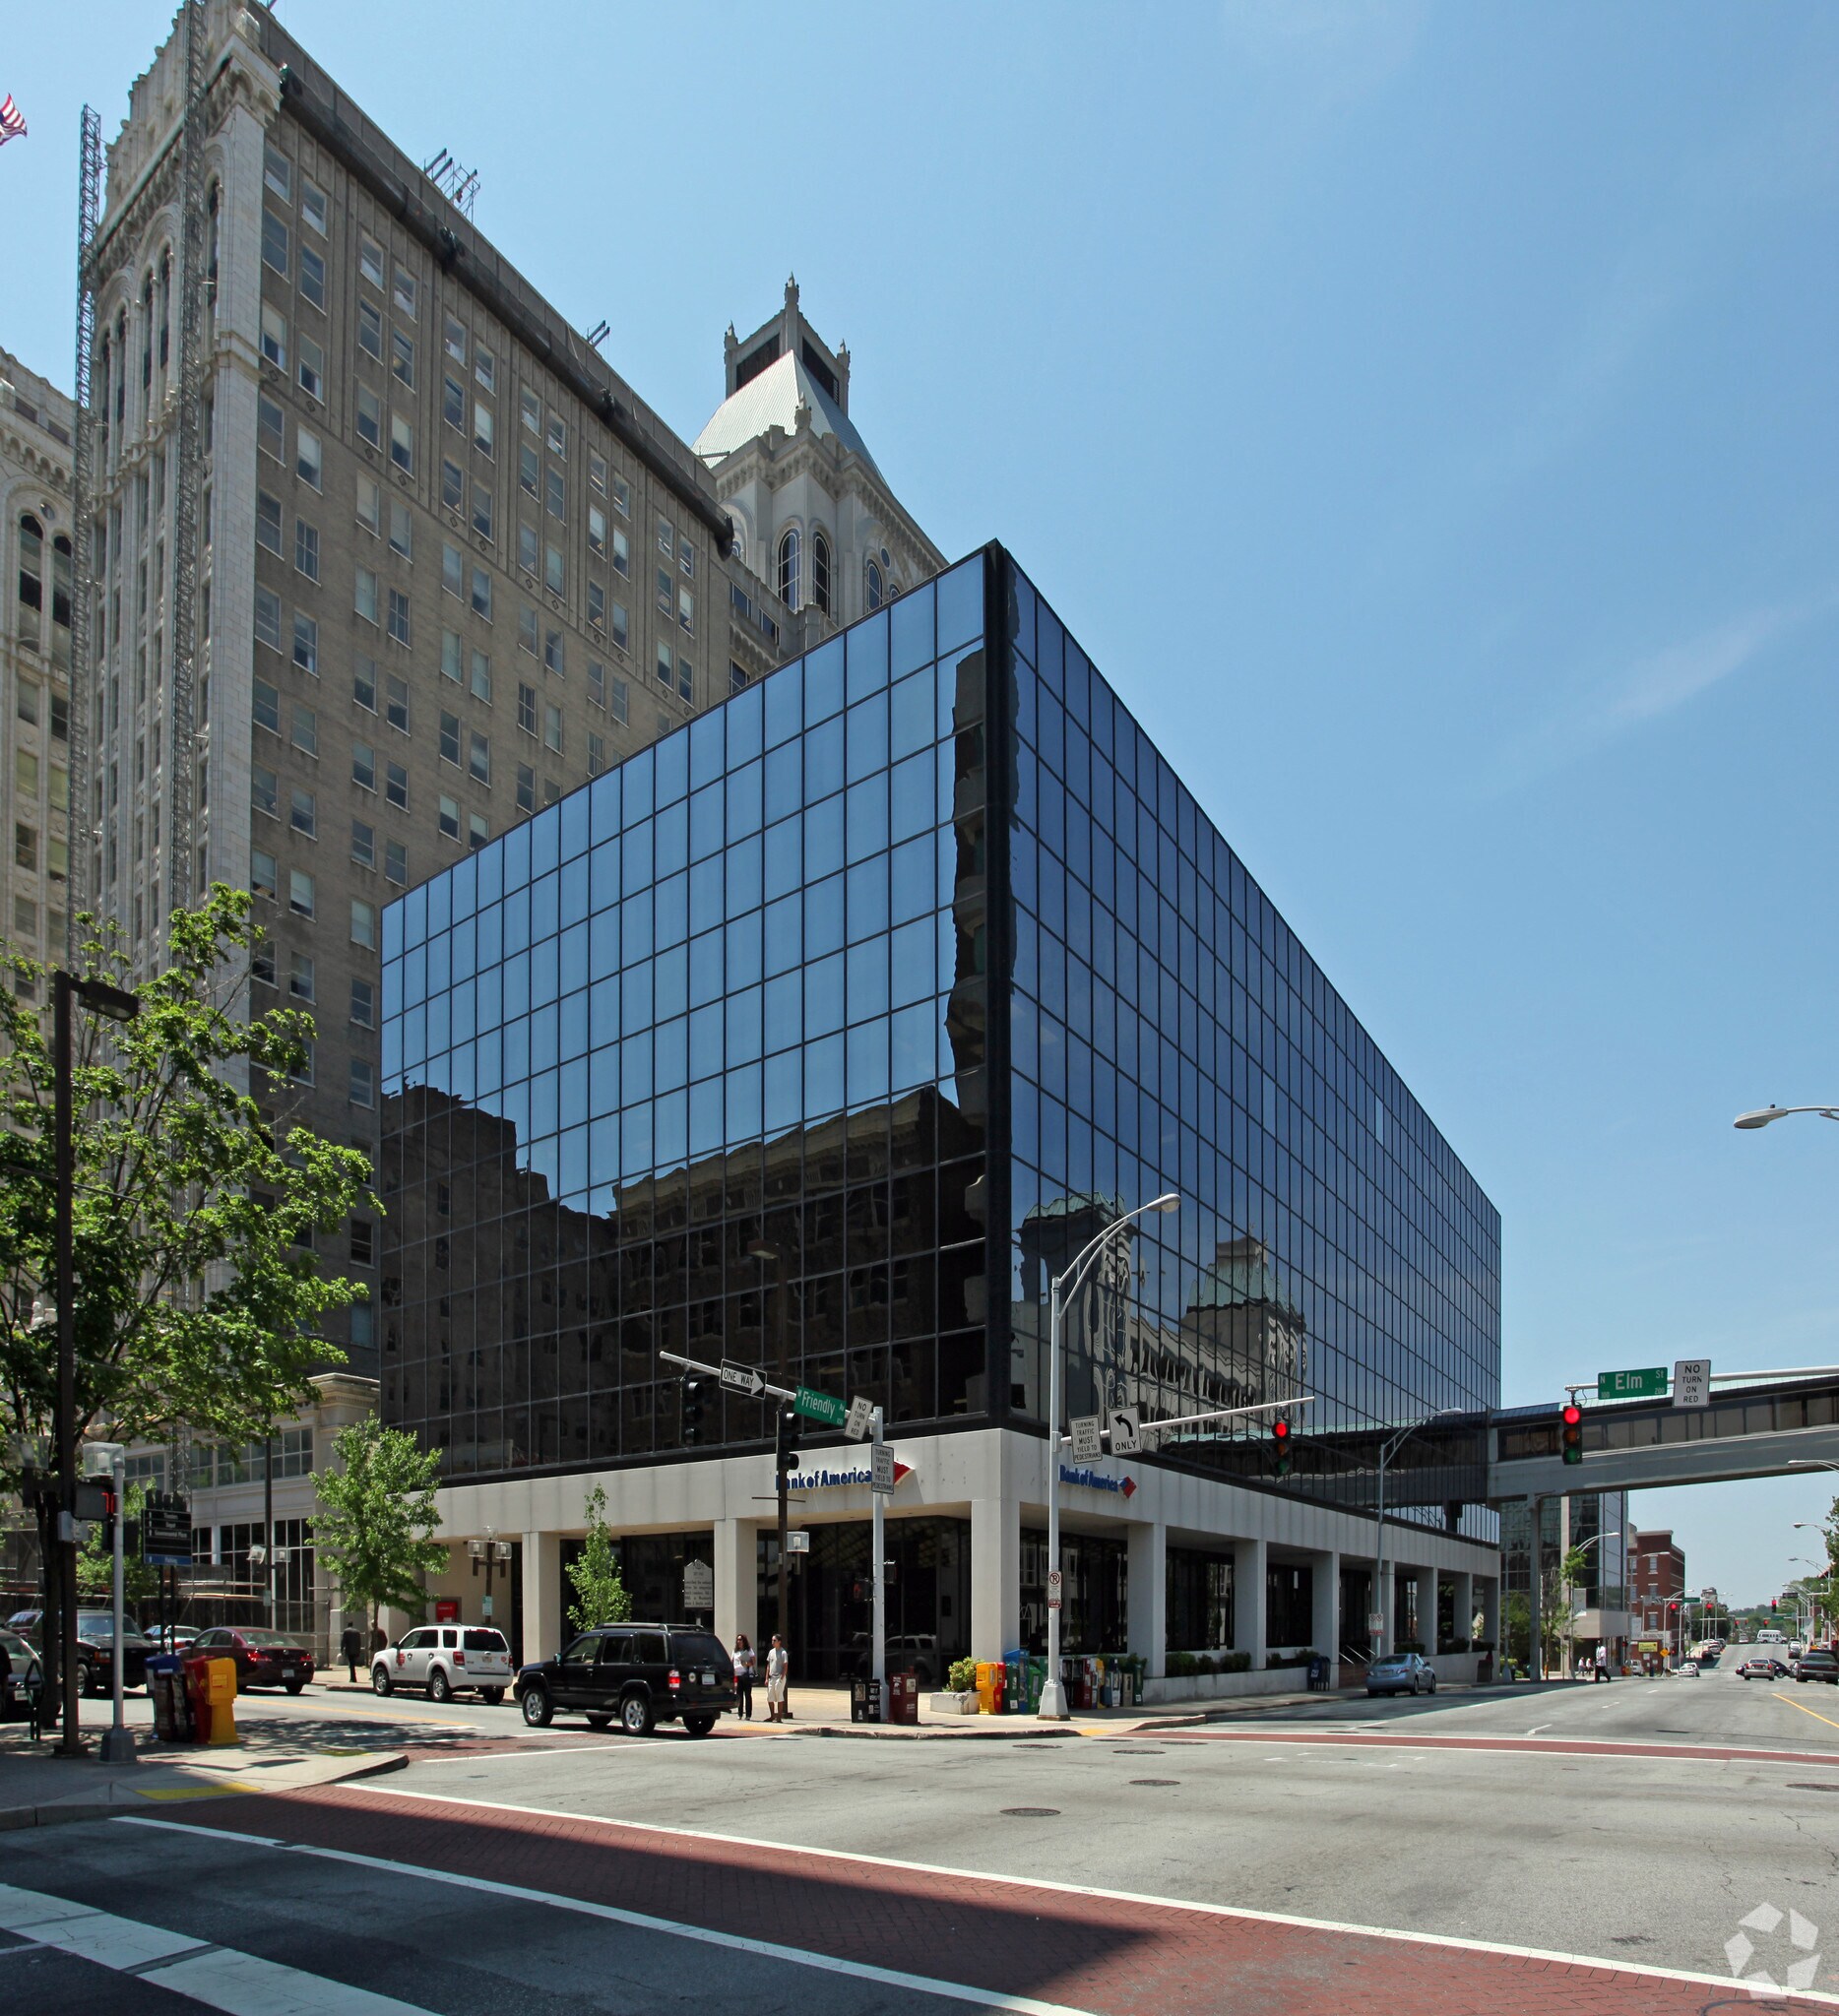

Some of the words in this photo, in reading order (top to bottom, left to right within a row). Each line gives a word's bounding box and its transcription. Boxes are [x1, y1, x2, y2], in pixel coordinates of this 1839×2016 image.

[1684, 1364, 1701, 1374] NO
[724, 1369, 737, 1383] ONE
[740, 1373, 755, 1387] WAY
[1600, 1375, 1606, 1384] N
[1616, 1372, 1643, 1390] Elm
[1655, 1369, 1664, 1379] St
[1682, 1375, 1702, 1384] TURN
[1685, 1385, 1697, 1394] ON
[801, 1391, 836, 1419] Friendly
[857, 1402, 867, 1412] NO
[854, 1411, 865, 1420] TURN
[1075, 1420, 1095, 1429] TURNING
[851, 1427, 859, 1436] RED
[1078, 1436, 1094, 1445] MUST
[1114, 1439, 1137, 1452] ONLY
[875, 1449, 891, 1458] TURNING
[1074, 1452, 1101, 1461] PEDESTRIANS
[875, 1457, 890, 1466] TRAFFIC
[876, 1466, 889, 1475] MUST
[806, 1470, 819, 1488] of
[820, 1467, 872, 1486] America
[1059, 1465, 1080, 1483] Bank
[1089, 1471, 1118, 1492] America
